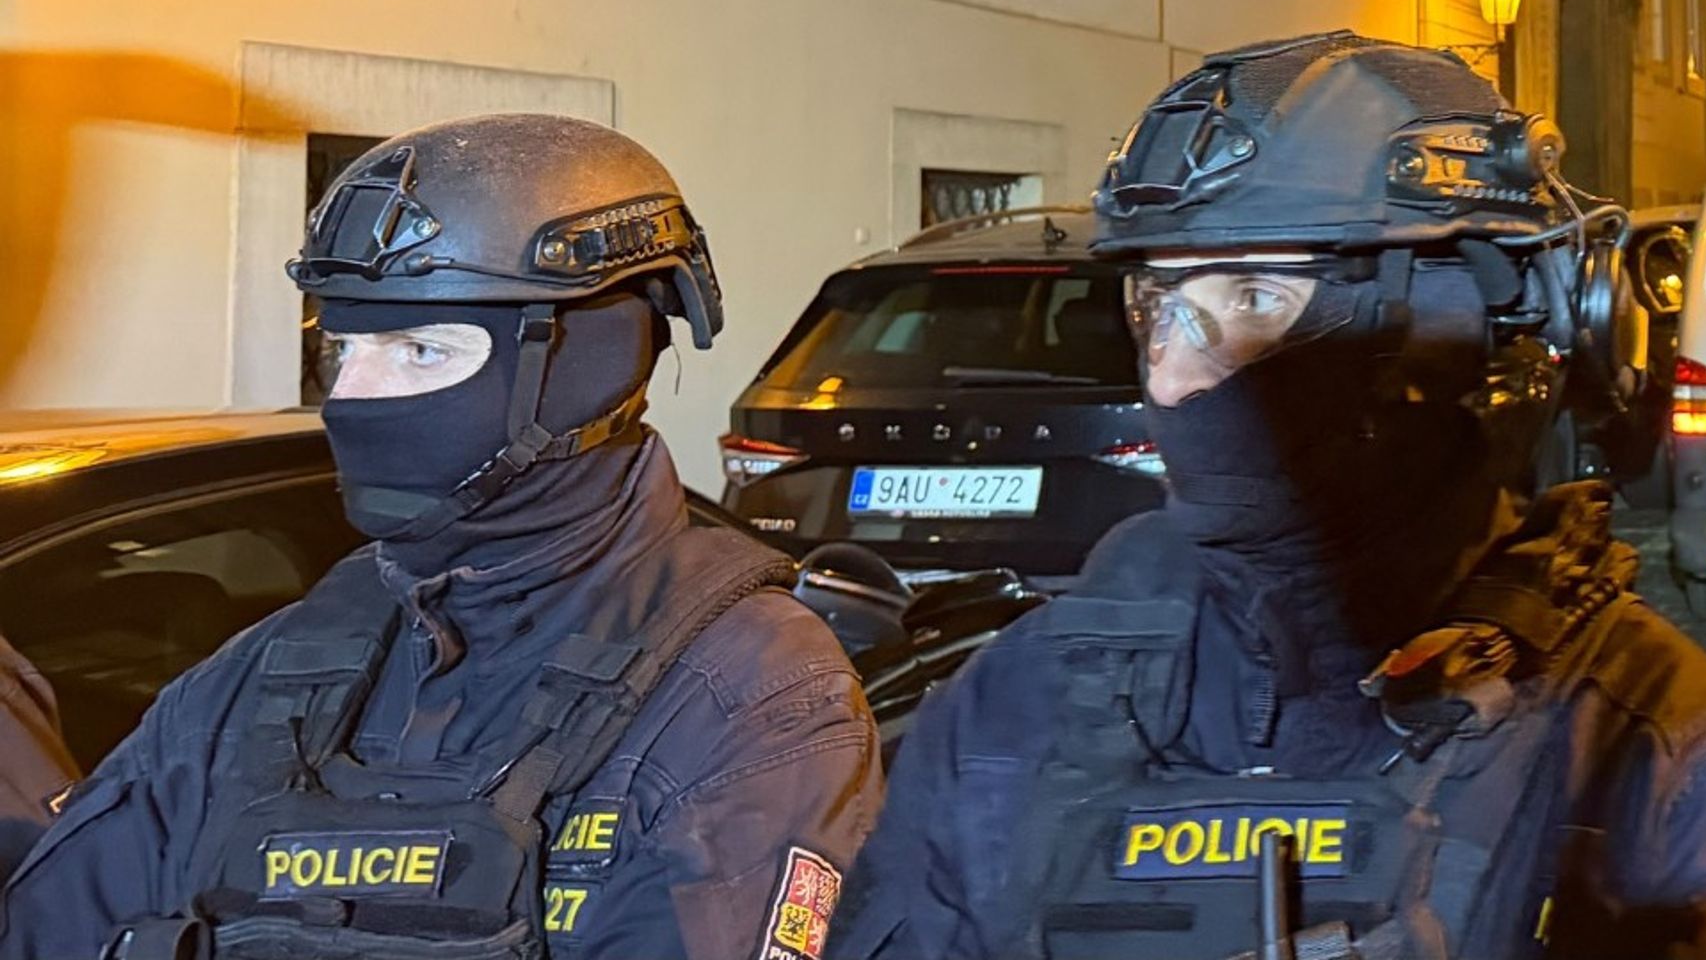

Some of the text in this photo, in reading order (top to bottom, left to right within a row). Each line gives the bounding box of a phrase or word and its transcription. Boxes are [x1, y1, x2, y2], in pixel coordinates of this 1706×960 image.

[877, 476, 1024, 504] 9AU 4272
[1122, 817, 1346, 866] POLICIE
[266, 846, 440, 888] POLICIE
[544, 887, 588, 931] 27
